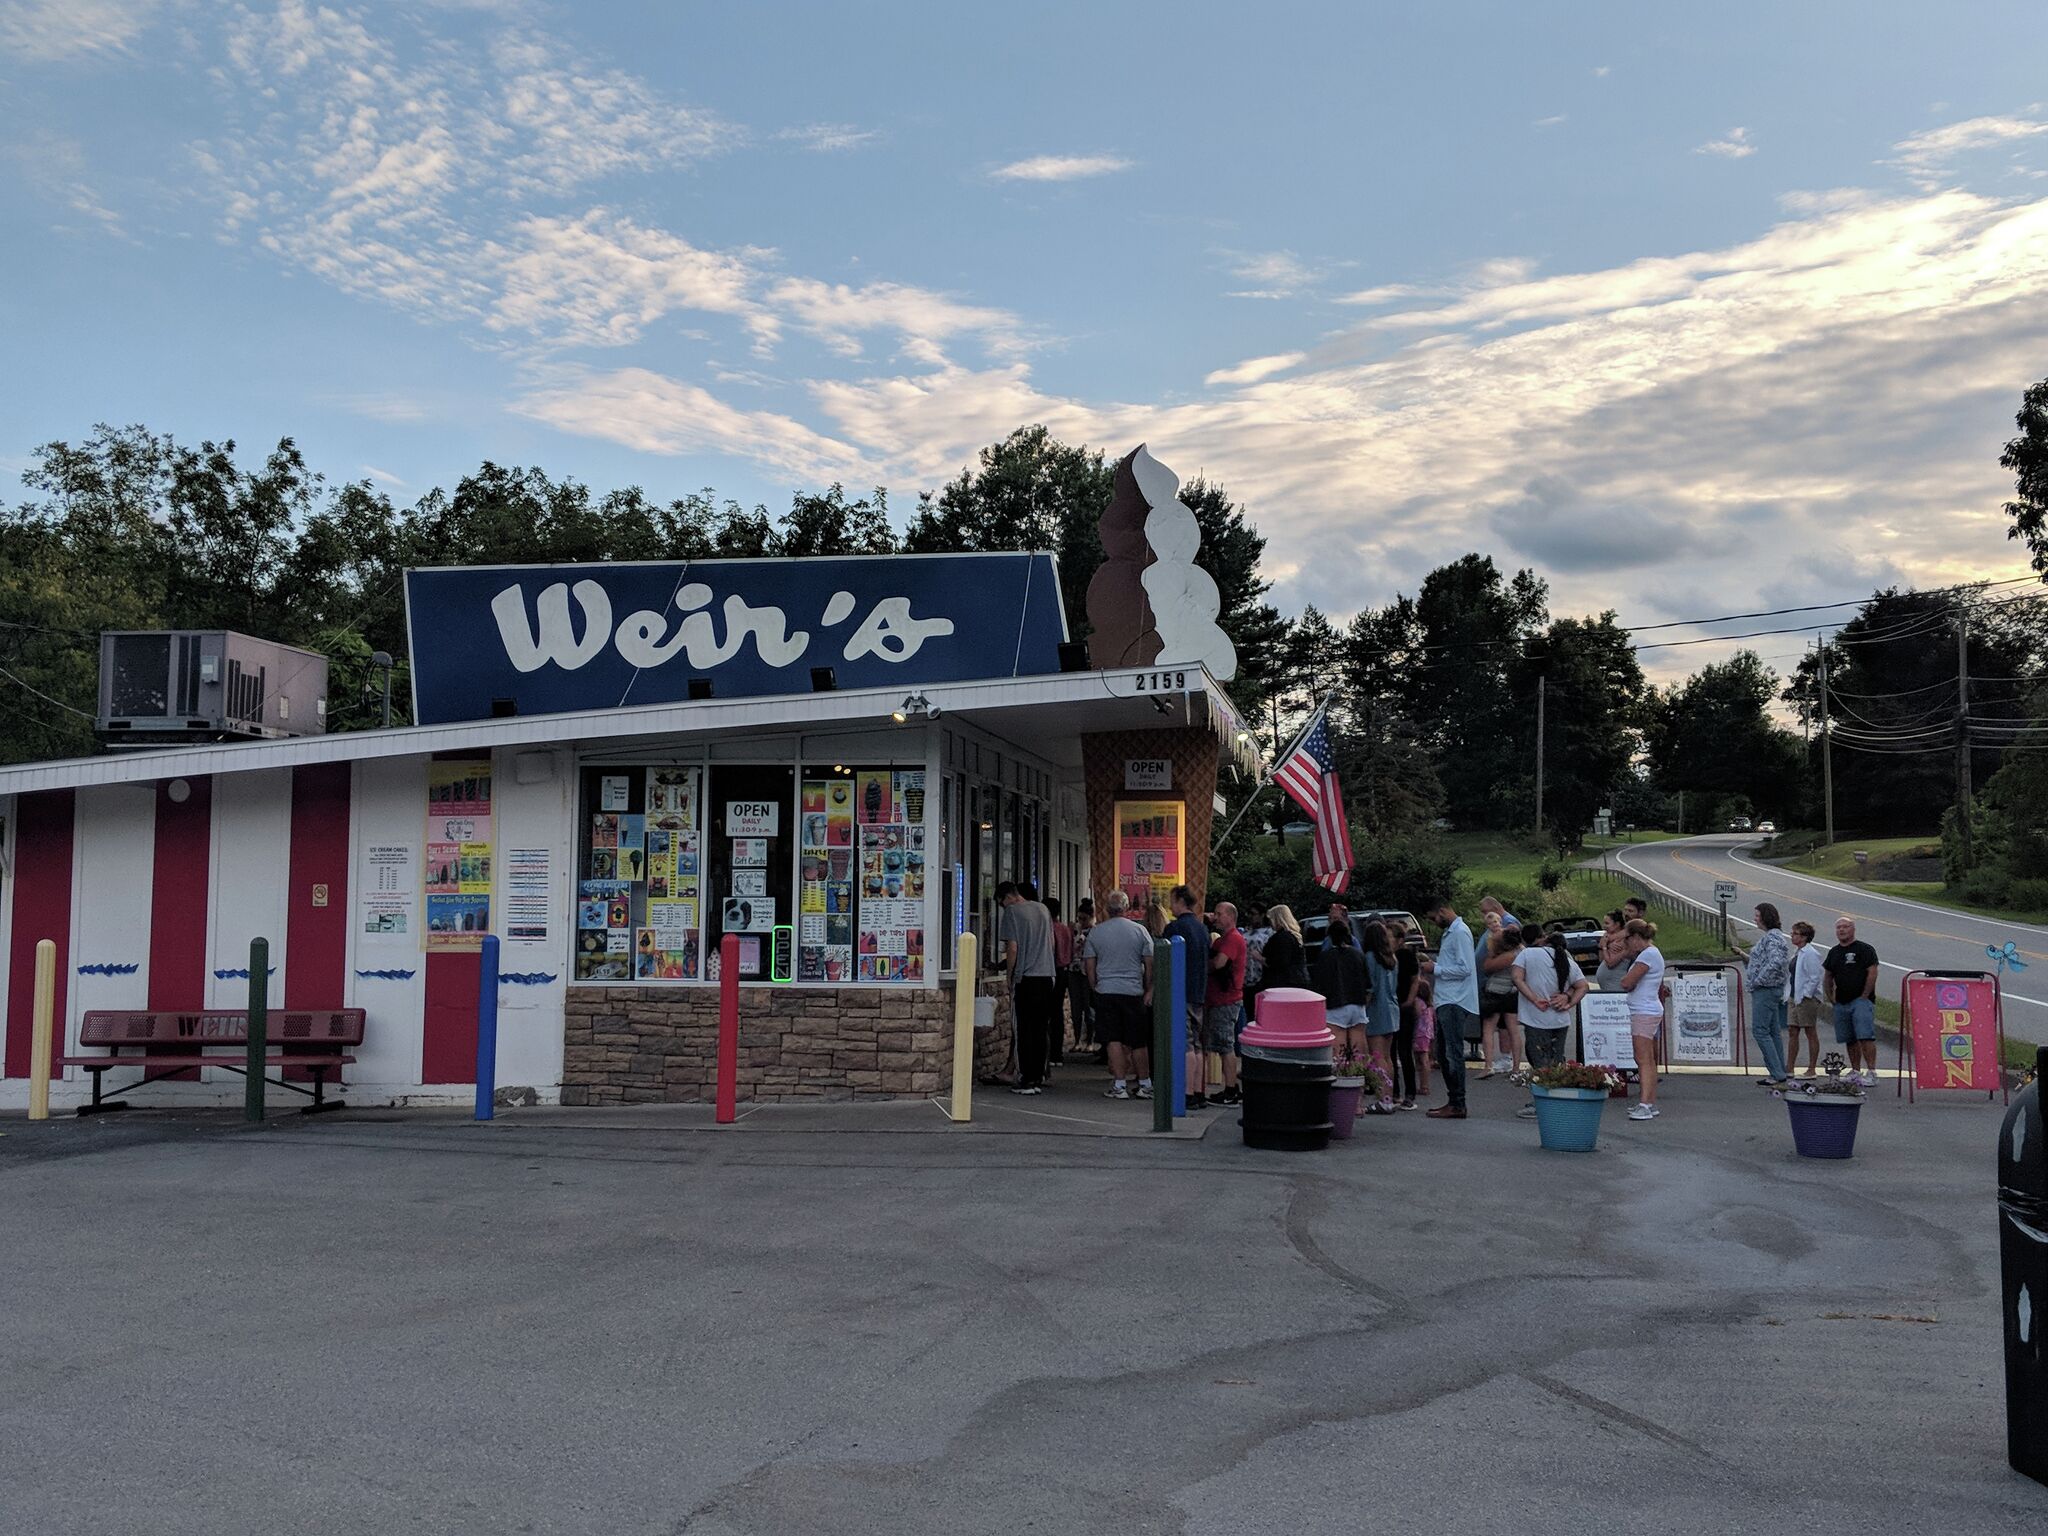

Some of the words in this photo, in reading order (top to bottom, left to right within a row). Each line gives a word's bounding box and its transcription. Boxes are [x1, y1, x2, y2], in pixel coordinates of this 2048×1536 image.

[491, 579, 954, 673] Weir's
[1136, 672, 1185, 690] 2159
[1131, 761, 1164, 773] OPEN
[733, 804, 770, 817] OPEN
[735, 856, 747, 865] Gift
[748, 856, 766, 865] Cards
[1716, 884, 1736, 892] ENTER
[776, 929, 790, 978] OPEN
[1673, 980, 1683, 997] Ice
[1685, 980, 1707, 998] Cream
[1708, 978, 1727, 998] Cakes
[1678, 1039, 1705, 1055] Available
[1706, 1041, 1728, 1058] Today!
